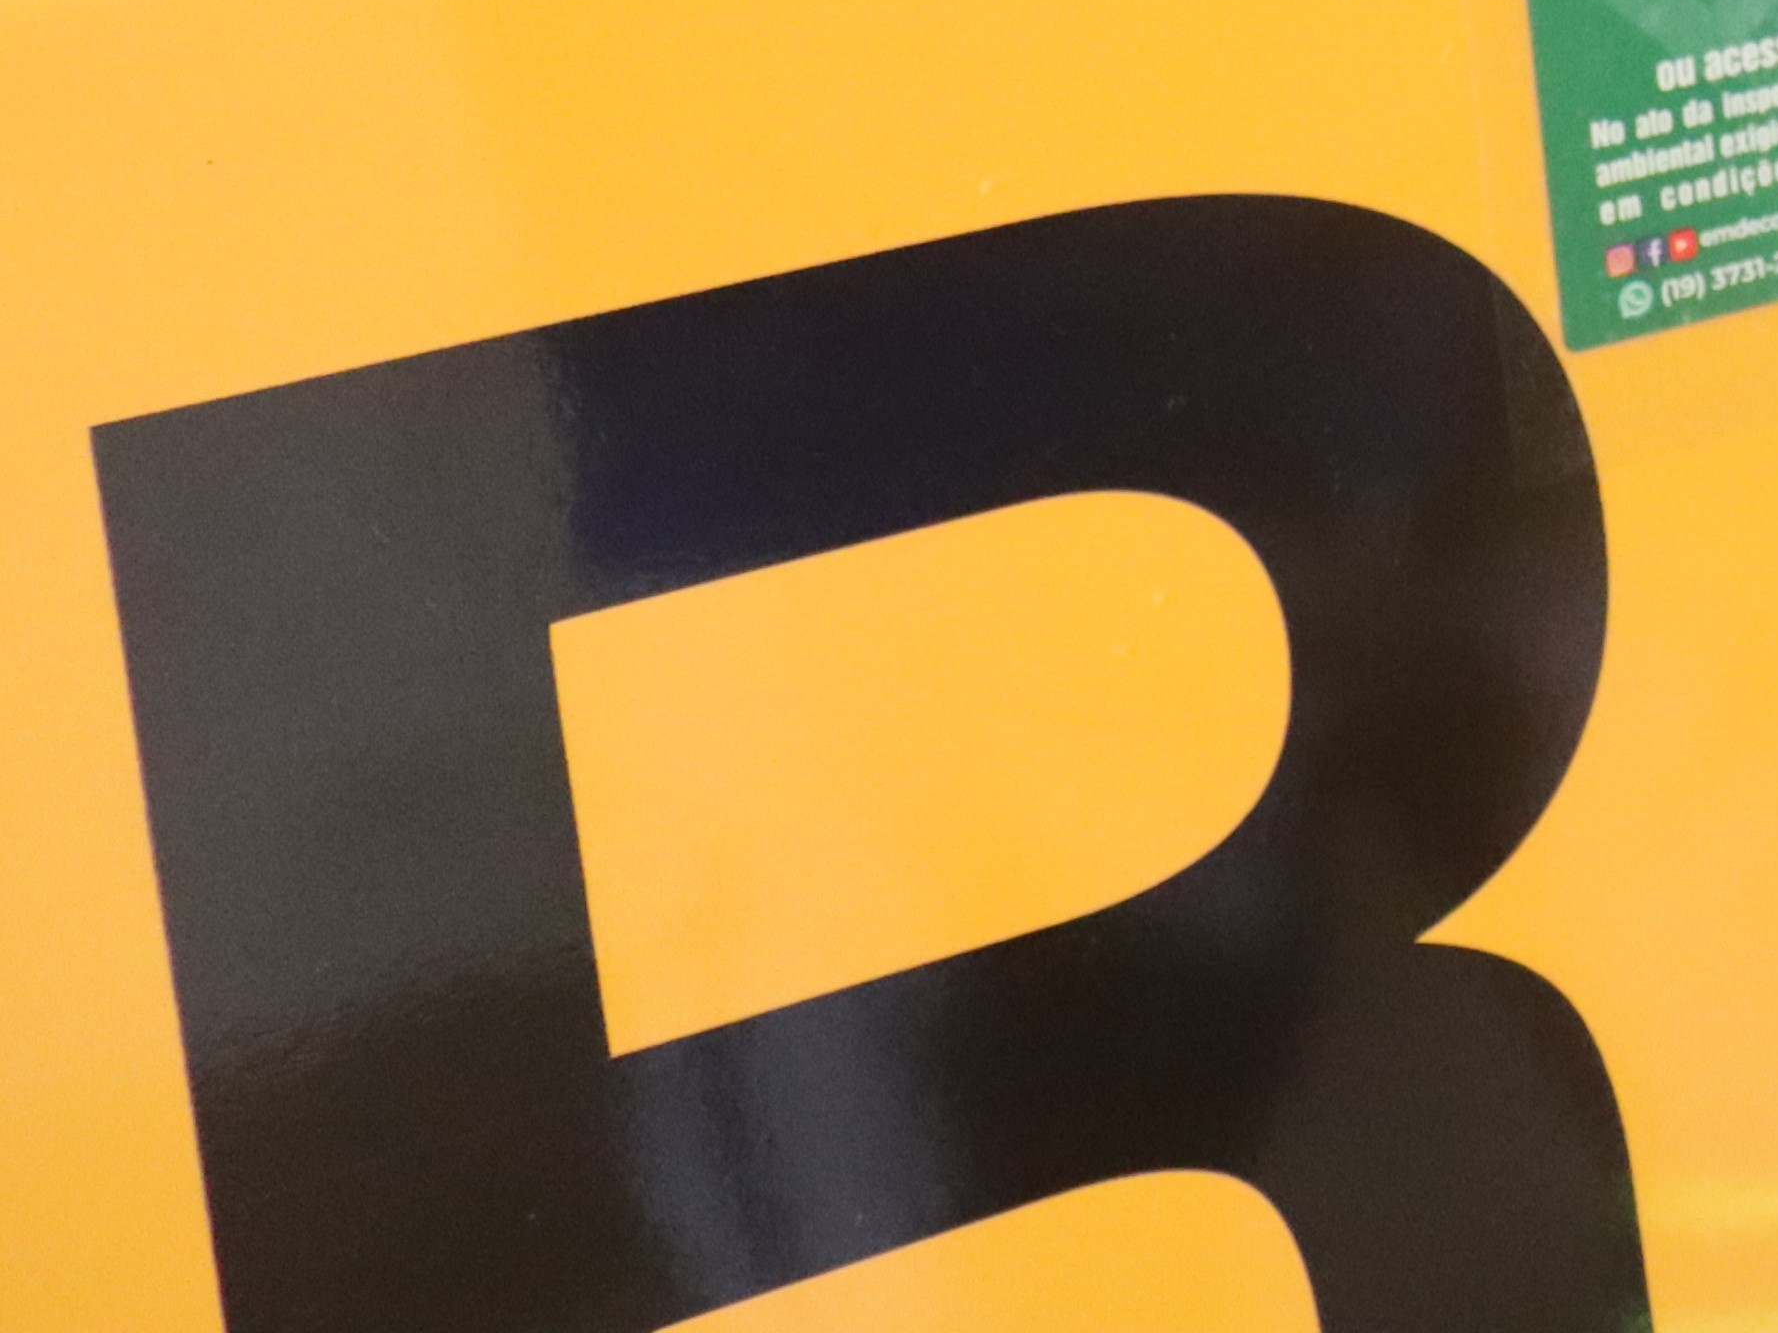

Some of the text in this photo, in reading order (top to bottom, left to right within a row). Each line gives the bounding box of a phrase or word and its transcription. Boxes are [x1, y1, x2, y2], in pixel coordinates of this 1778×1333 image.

[1656, 54, 1697, 93] ou
[1590, 119, 1625, 149] No
[1635, 109, 1674, 139] ato
[1682, 99, 1714, 128] da
[1596, 133, 1715, 187] ambiental
[1599, 194, 1642, 225] em
[1661, 271, 1706, 308] (19)
